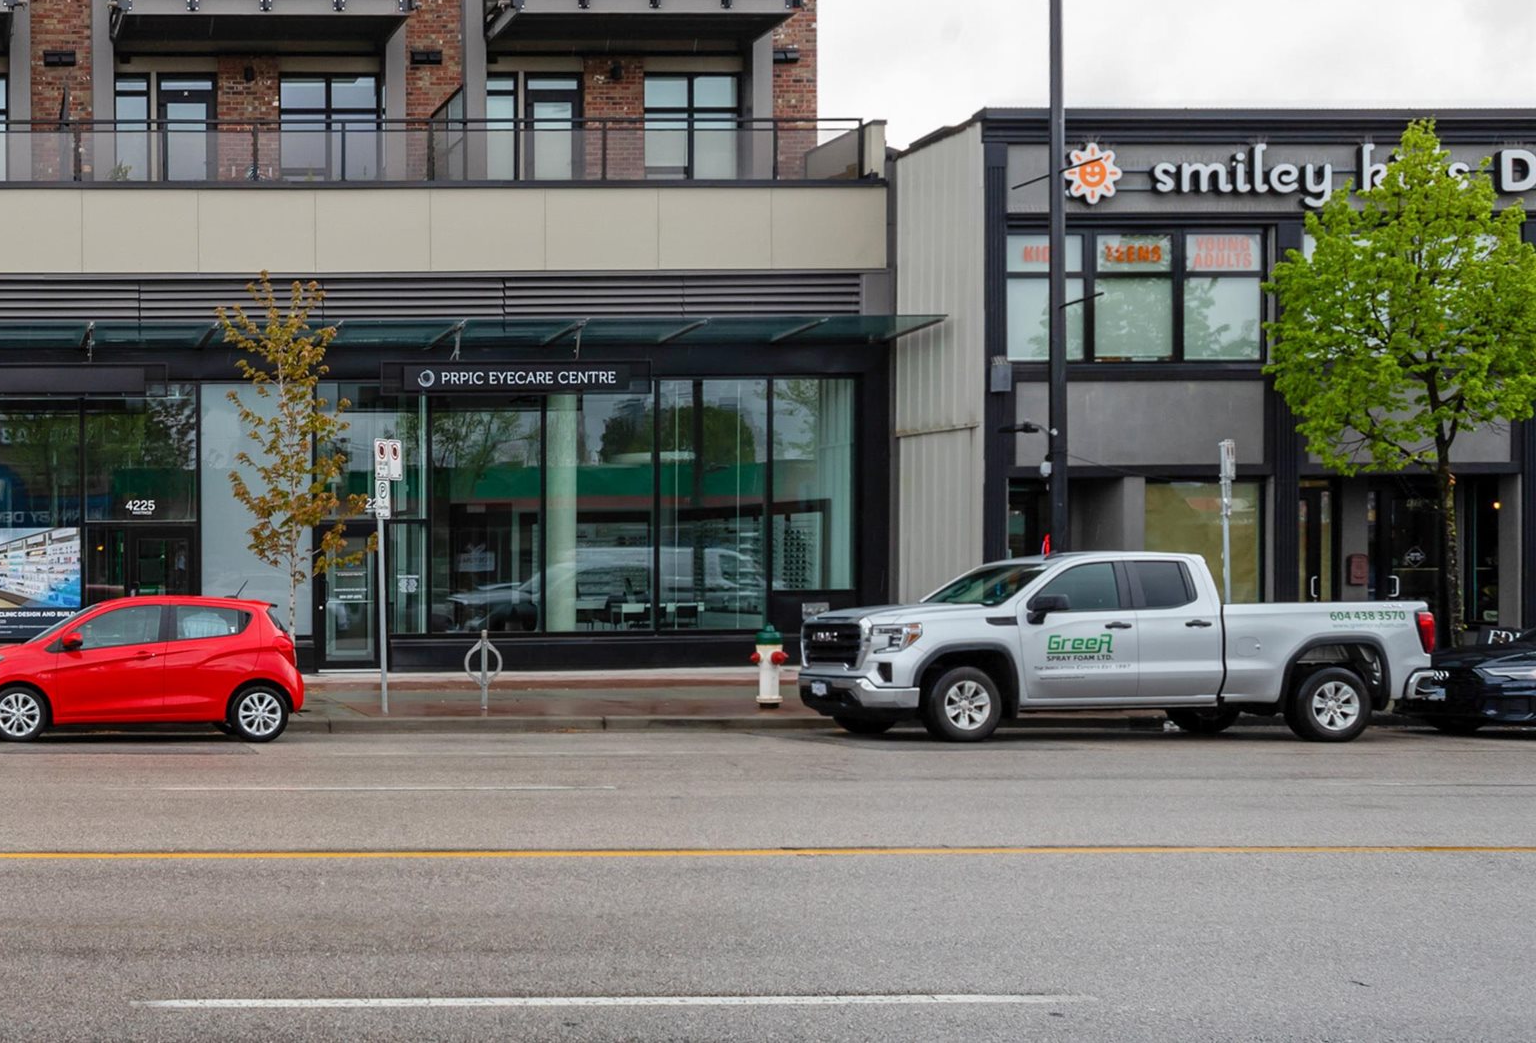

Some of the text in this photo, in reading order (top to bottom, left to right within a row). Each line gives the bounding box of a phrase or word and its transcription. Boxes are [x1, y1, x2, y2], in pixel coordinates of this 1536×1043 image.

[1154, 144, 1332, 207] smiley
[1363, 144, 1470, 193] ks
[1196, 236, 1251, 252] YOUNG
[1104, 244, 1162, 264] TEENS
[1194, 252, 1253, 269] ADULTS
[441, 371, 616, 385] PRPIC EYECARE CENTRE
[125, 500, 156, 511] 4225
[1330, 610, 1406, 621] 604 438 3570
